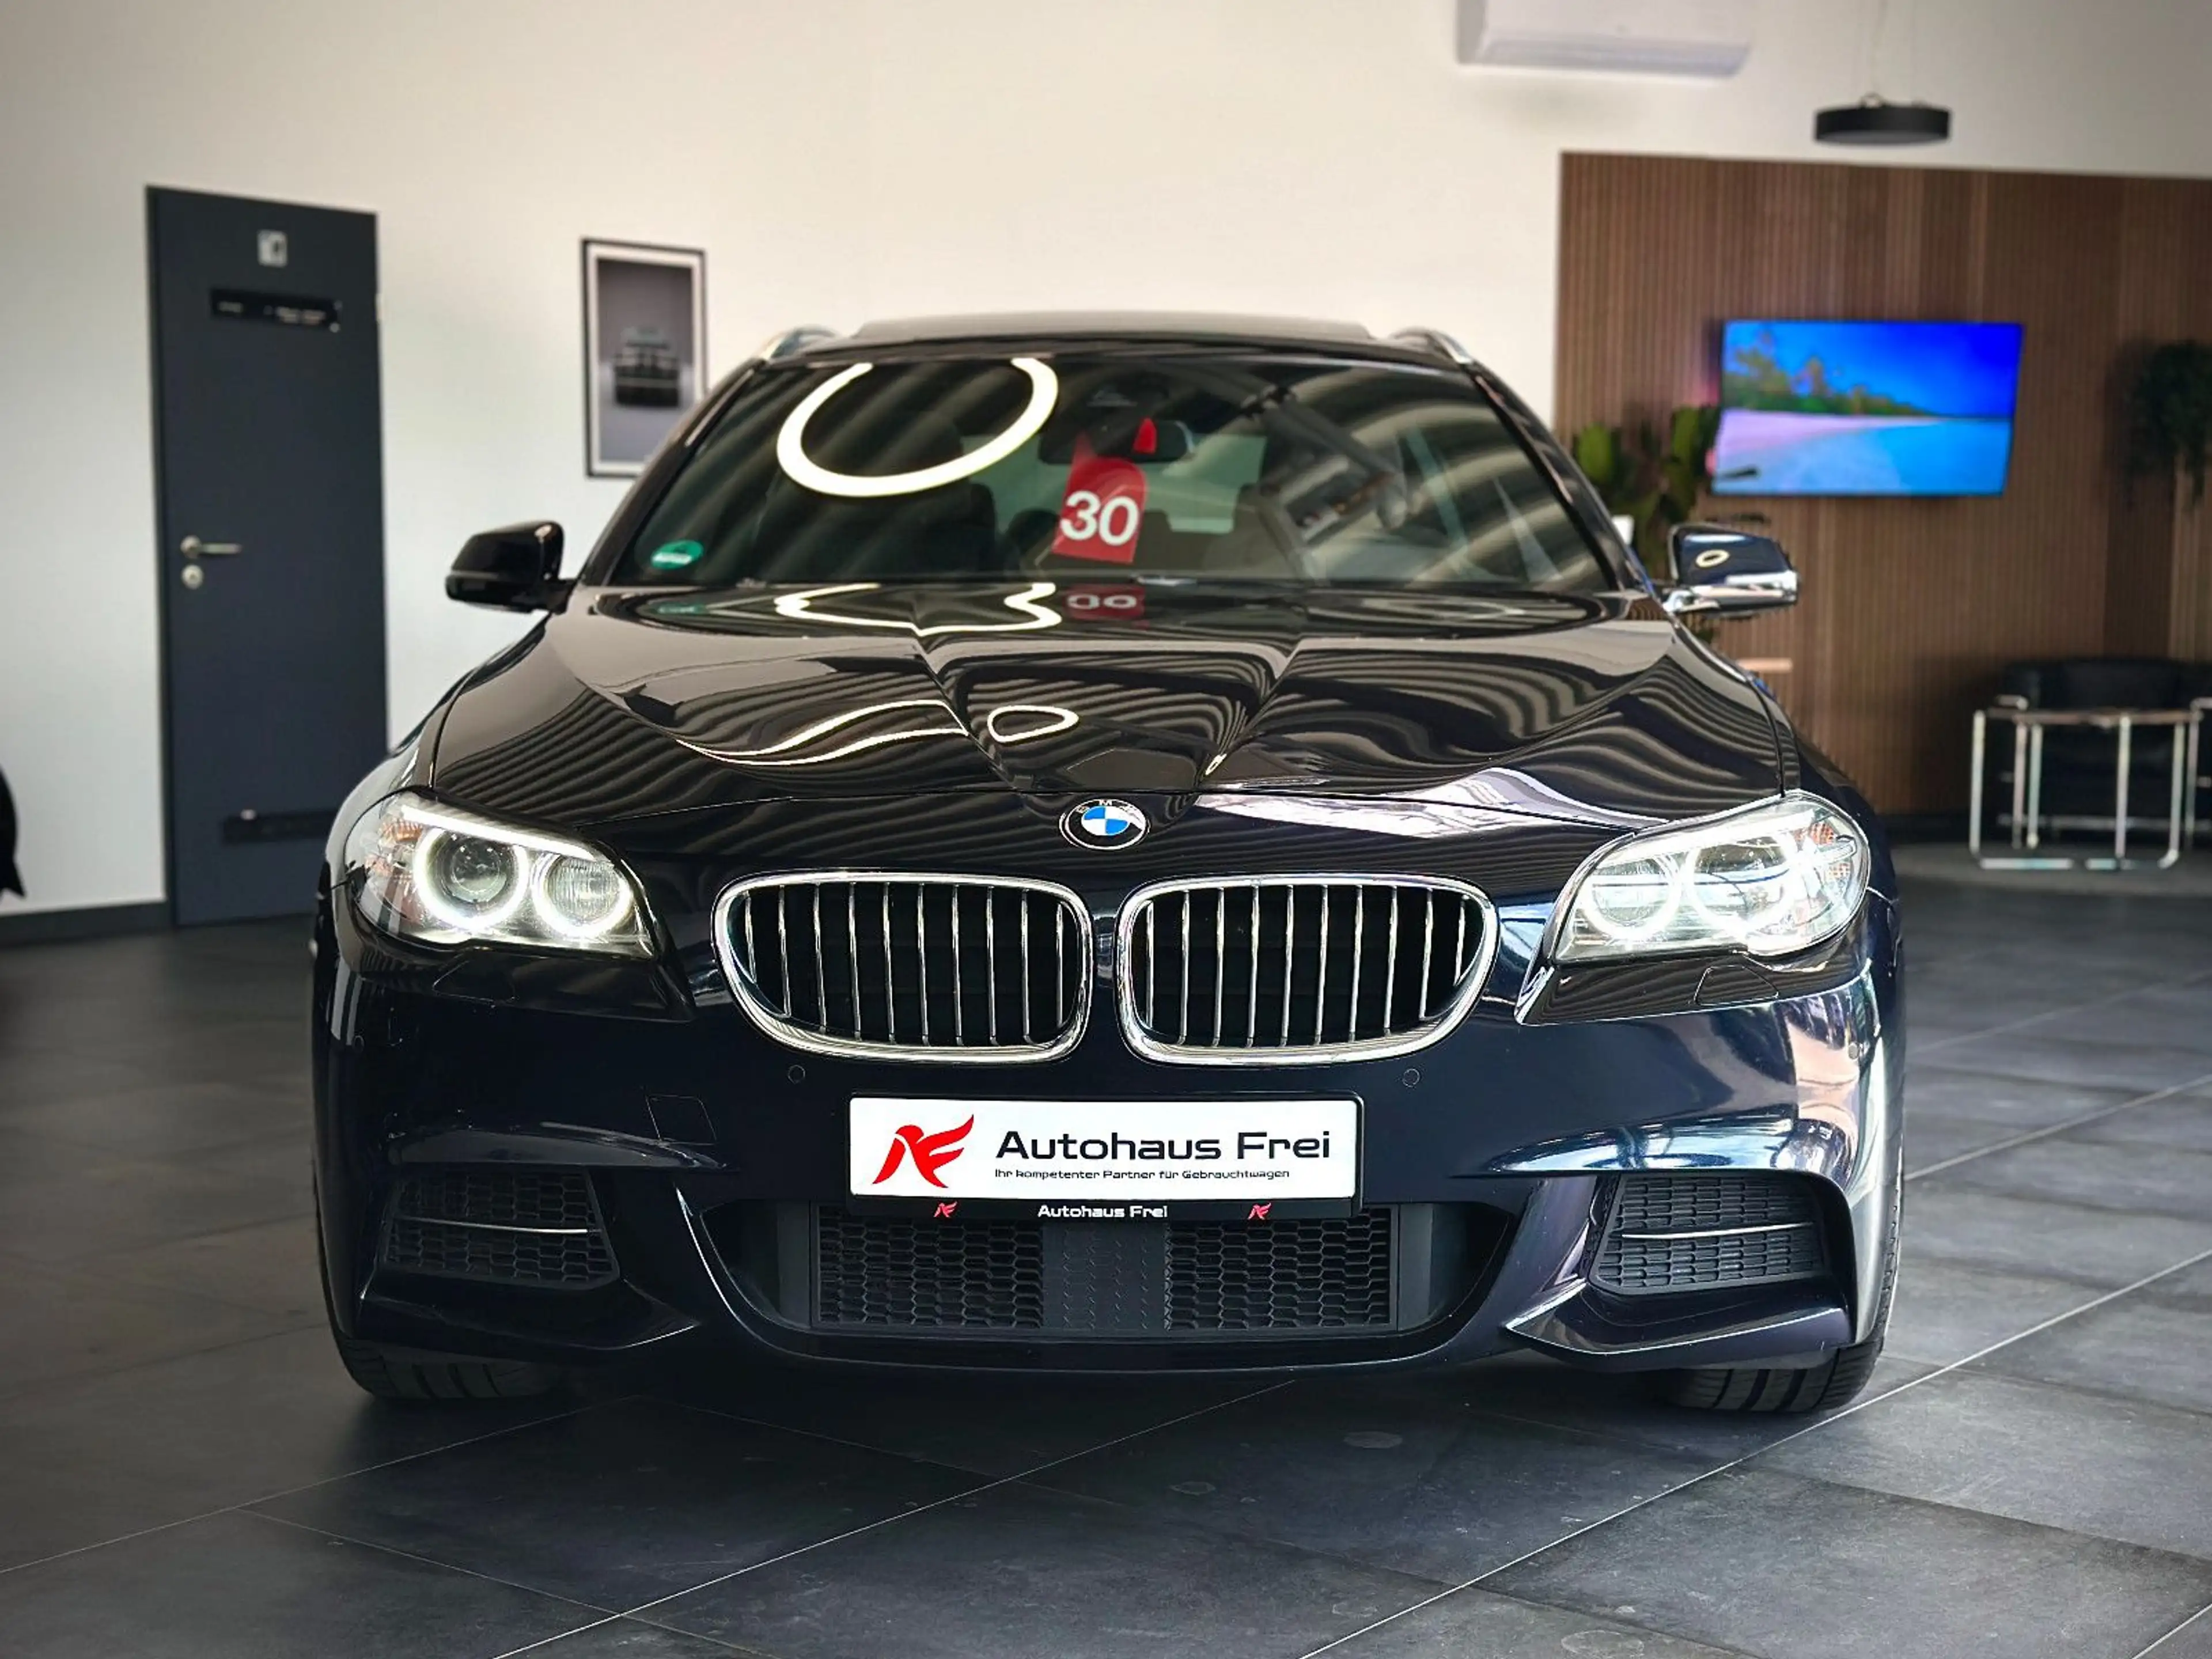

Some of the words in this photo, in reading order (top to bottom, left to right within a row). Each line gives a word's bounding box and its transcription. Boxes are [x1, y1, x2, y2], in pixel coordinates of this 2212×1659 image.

[1060, 490, 1139, 546] 30
[995, 1130, 1222, 1160] Autohaus
[1237, 1130, 1330, 1160] Frei
[995, 1169, 1013, 1178] Ihr
[1016, 1169, 1100, 1180] kompetenter
[1103, 1170, 1156, 1179] Partner
[1158, 1170, 1179, 1179] für
[1181, 1170, 1290, 1180] Gebrauchtwagen
[1037, 1204, 1125, 1218] Autohaus
[1129, 1205, 1168, 1218] Frei
